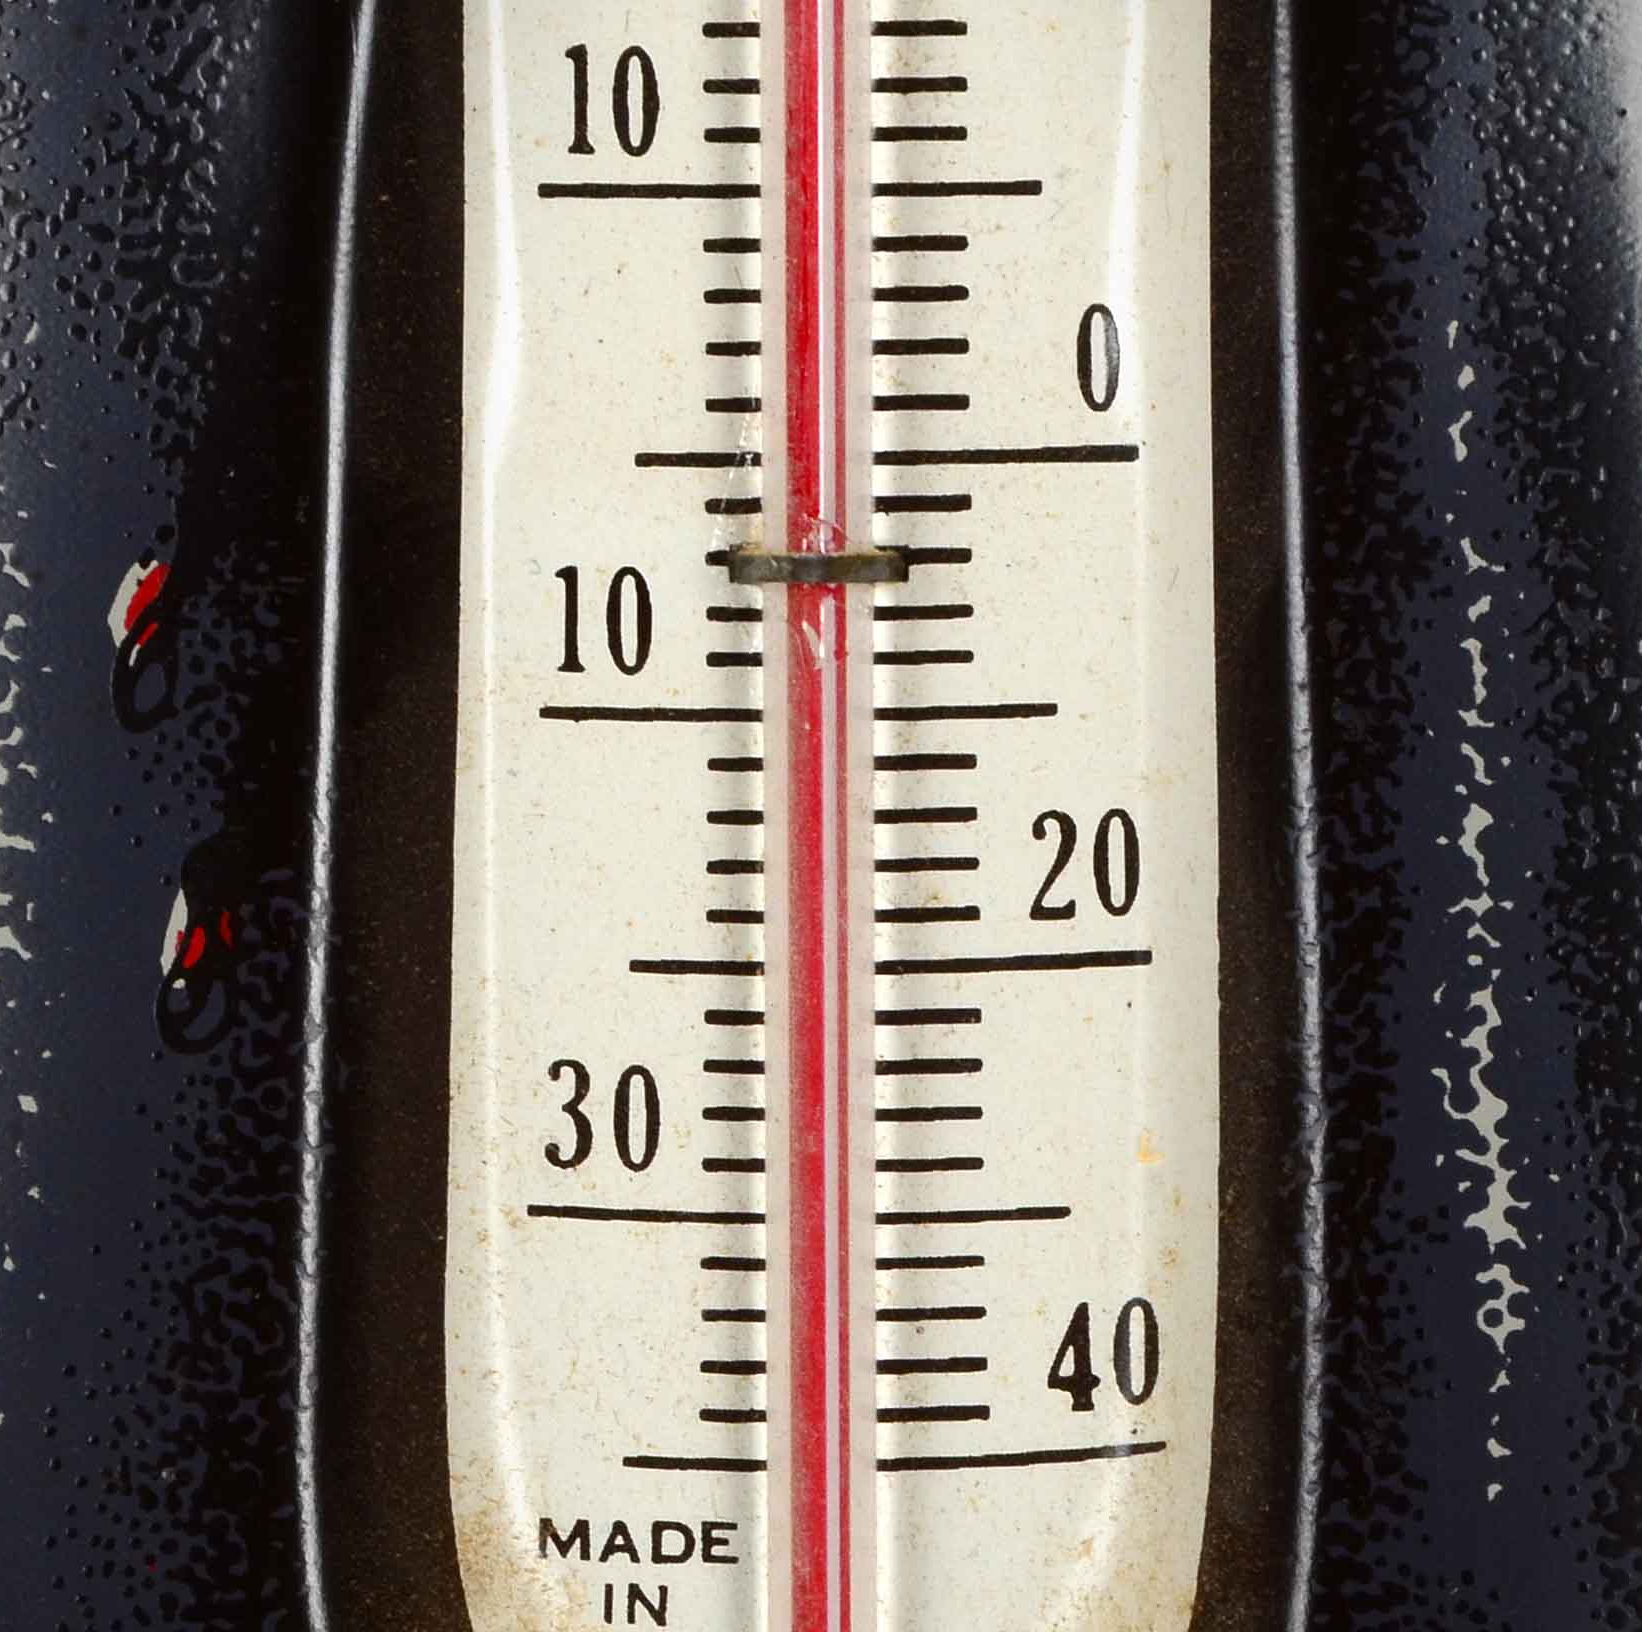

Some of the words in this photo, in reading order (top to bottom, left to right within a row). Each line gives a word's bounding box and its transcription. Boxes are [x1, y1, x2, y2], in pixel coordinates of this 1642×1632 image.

[564, 43, 660, 157] 10
[1076, 303, 1120, 412] 0
[555, 565, 653, 676] 10
[1029, 808, 1140, 921] 20
[544, 1059, 661, 1173] 30
[1047, 1297, 1160, 1412] 40
[538, 1517, 740, 1565] MADE
[603, 1582, 668, 1627] IN
